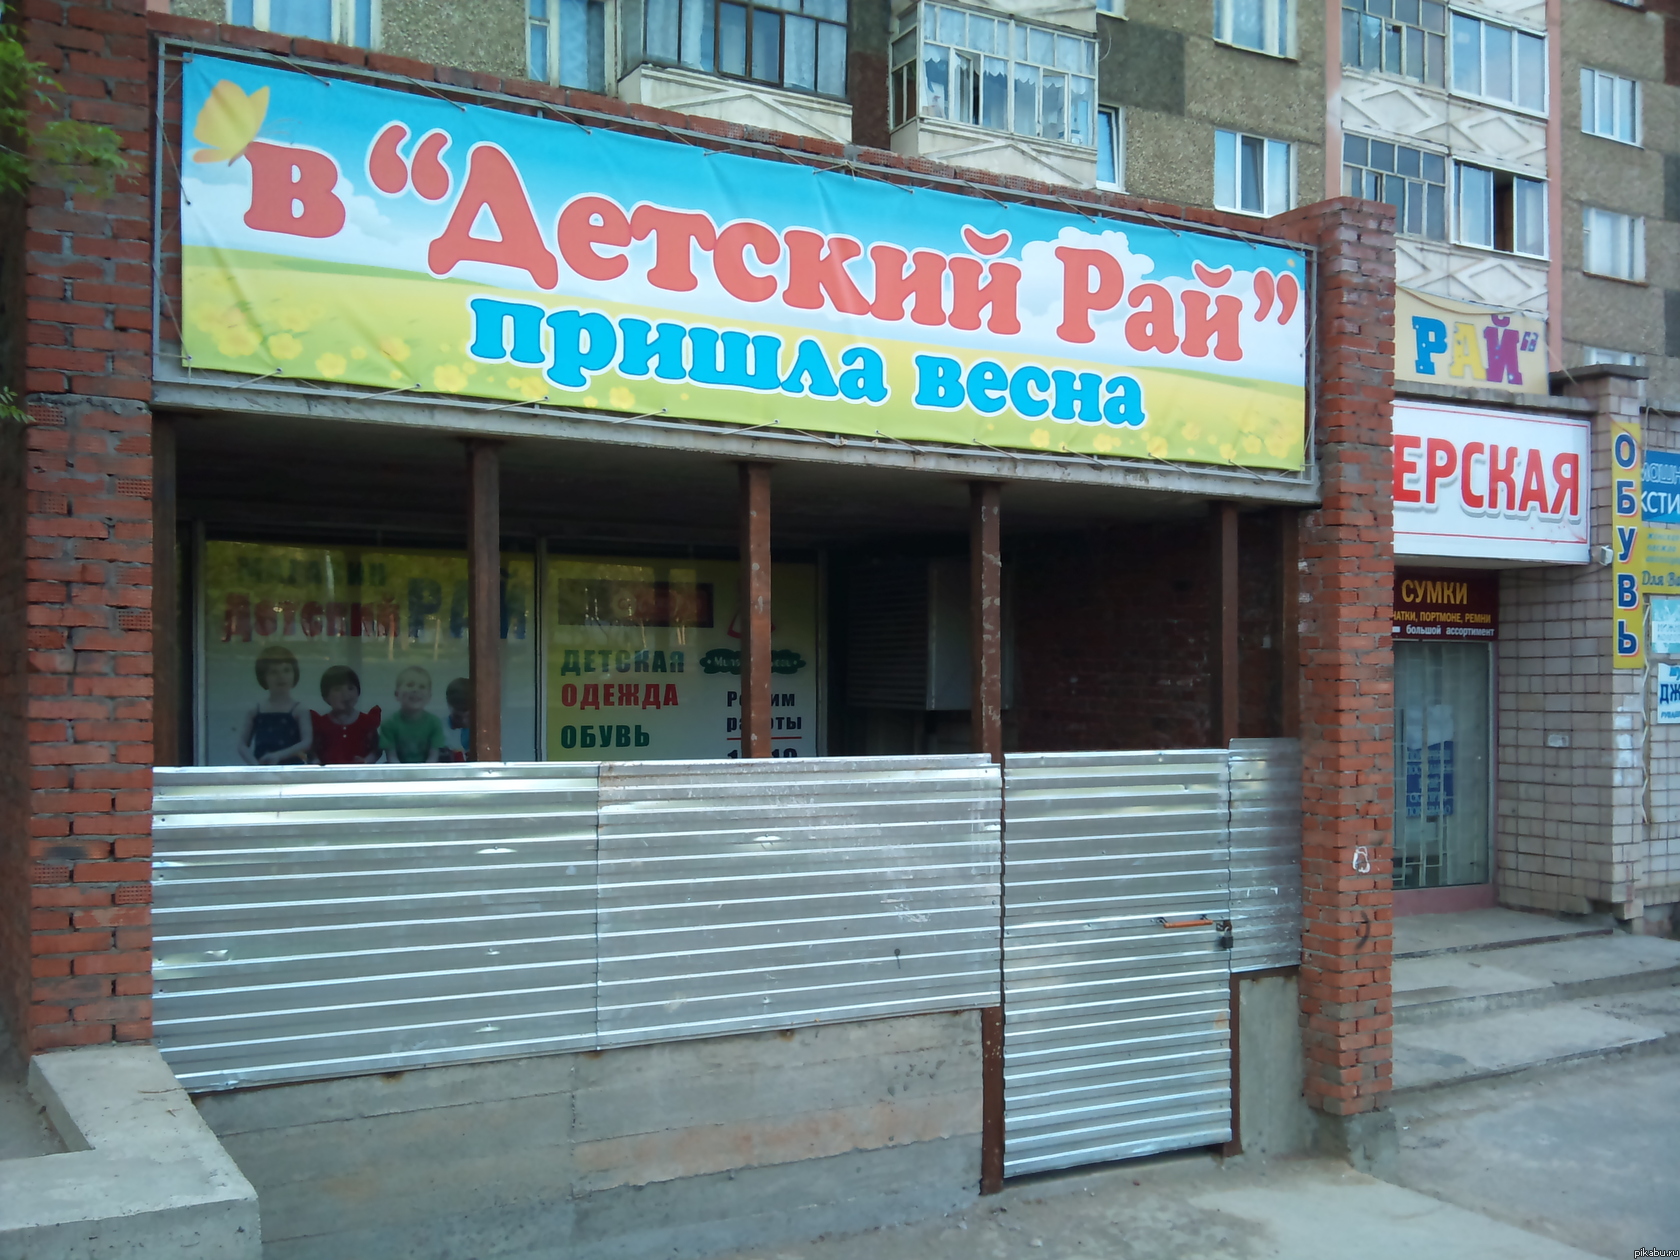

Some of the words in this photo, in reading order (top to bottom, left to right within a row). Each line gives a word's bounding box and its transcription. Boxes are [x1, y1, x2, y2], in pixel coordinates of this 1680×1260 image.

[244, 140, 346, 239] в
[469, 297, 889, 403] пришла
[914, 354, 1146, 428] весна
[1614, 432, 1638, 656] ОБУВЬ
[1401, 579, 1468, 605] СУМКИ
[1406, 624, 1442, 635] большой
[1446, 627, 1495, 637] ассортимент
[1420, 612, 1463, 623] ПОРТМОНЕ,
[1465, 613, 1491, 623] РЕМНИ
[560, 649, 685, 676] ДЕТСКАЯ
[561, 683, 679, 710] ОДЕЖДА
[727, 690, 796, 708] Рим
[560, 725, 650, 749] ОБУВЬ
